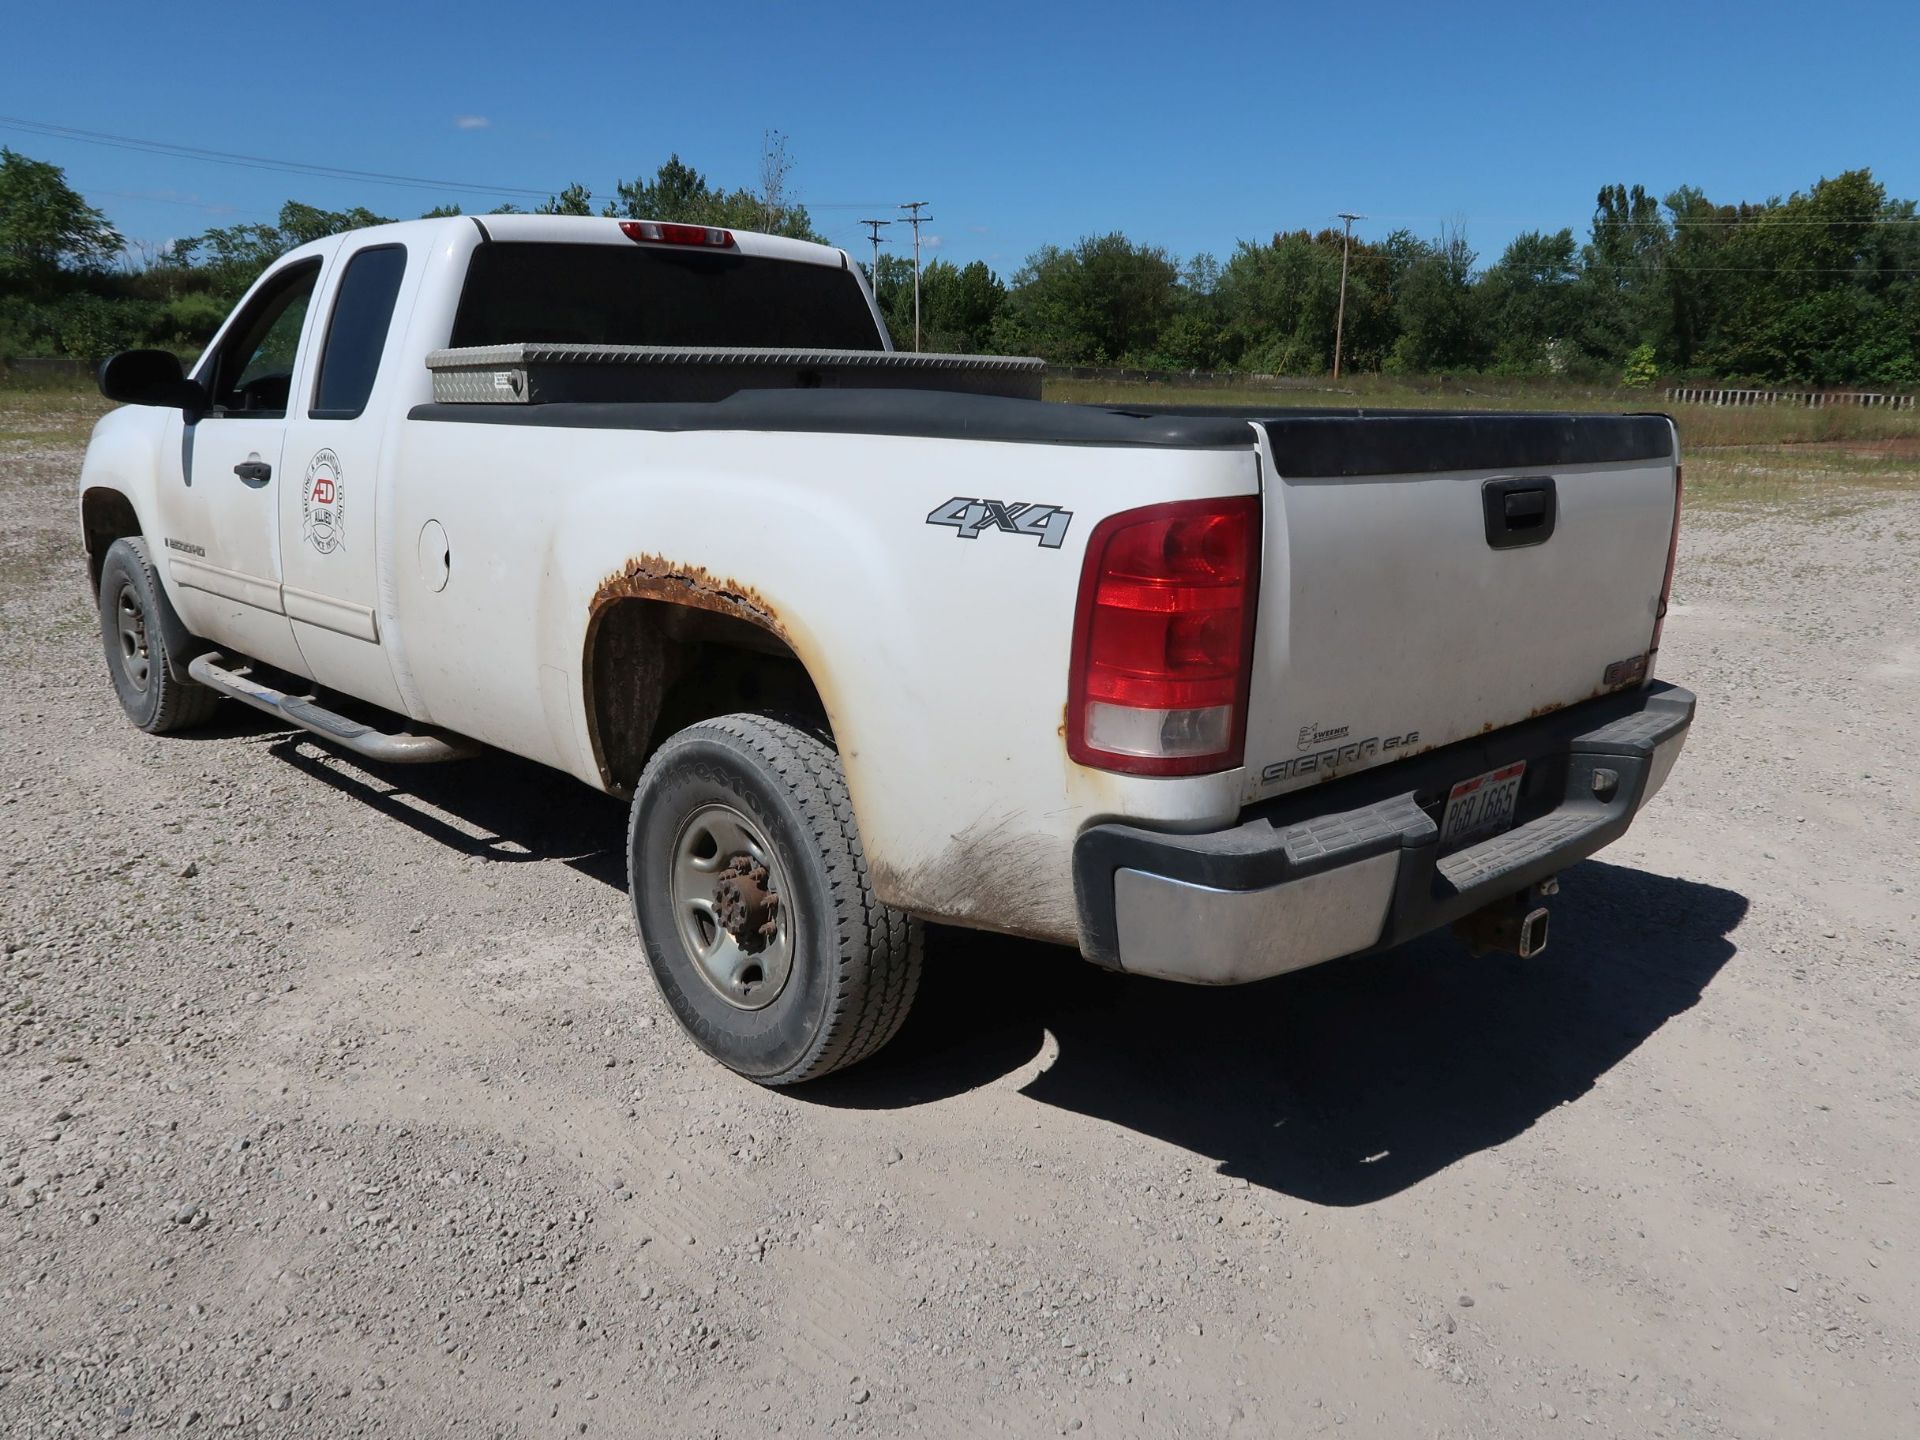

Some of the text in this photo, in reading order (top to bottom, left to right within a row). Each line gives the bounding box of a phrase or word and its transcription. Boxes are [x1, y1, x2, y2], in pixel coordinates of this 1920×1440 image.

[310, 479, 335, 504] AED
[315, 510, 332, 525] ALLIED
[1313, 725, 1350, 740] SWEENEY
[1261, 736, 1379, 786] SIERRA
[1382, 731, 1420, 751] SLE
